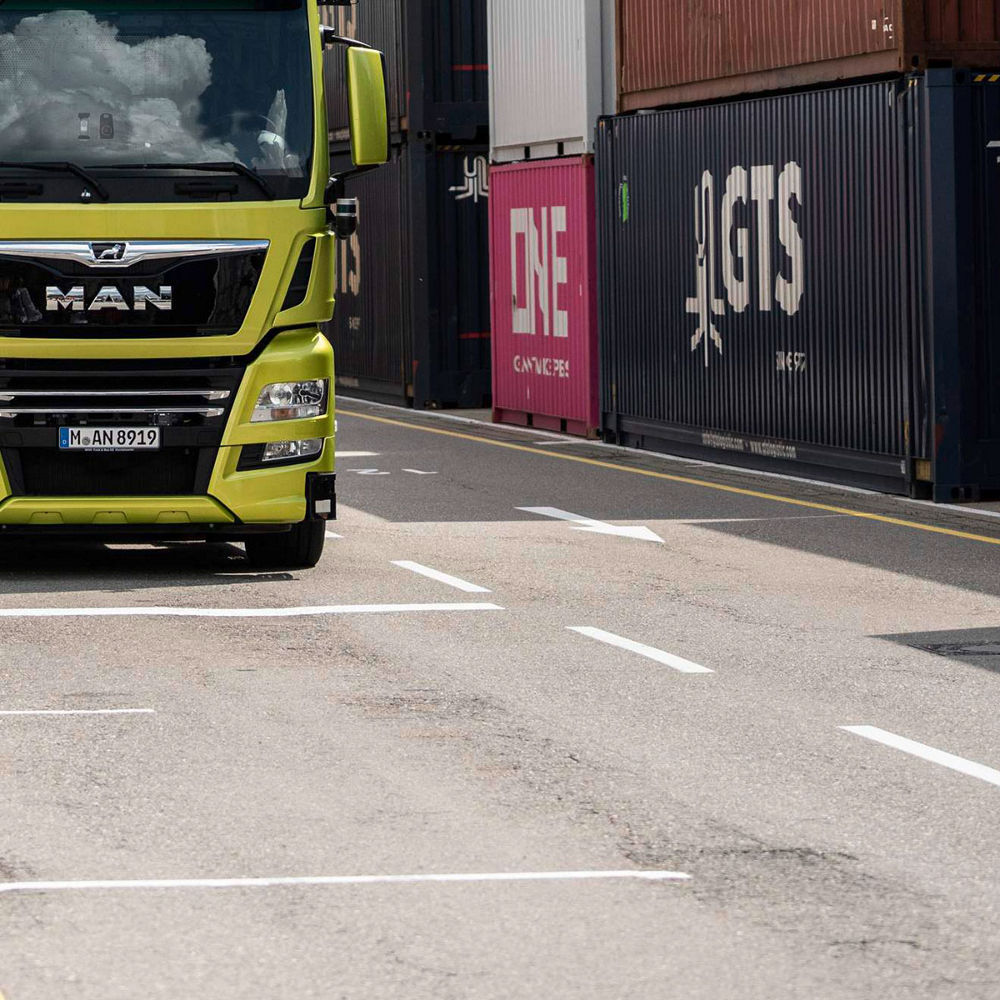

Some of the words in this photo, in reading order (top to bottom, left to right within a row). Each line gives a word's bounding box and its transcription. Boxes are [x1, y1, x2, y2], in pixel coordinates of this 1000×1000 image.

[510, 205, 569, 338] ONE
[721, 160, 804, 316] GTS
[46, 286, 172, 310] MAN
[70, 430, 81, 445] M
[92, 430, 113, 445] AN
[117, 430, 157, 445] 8919
